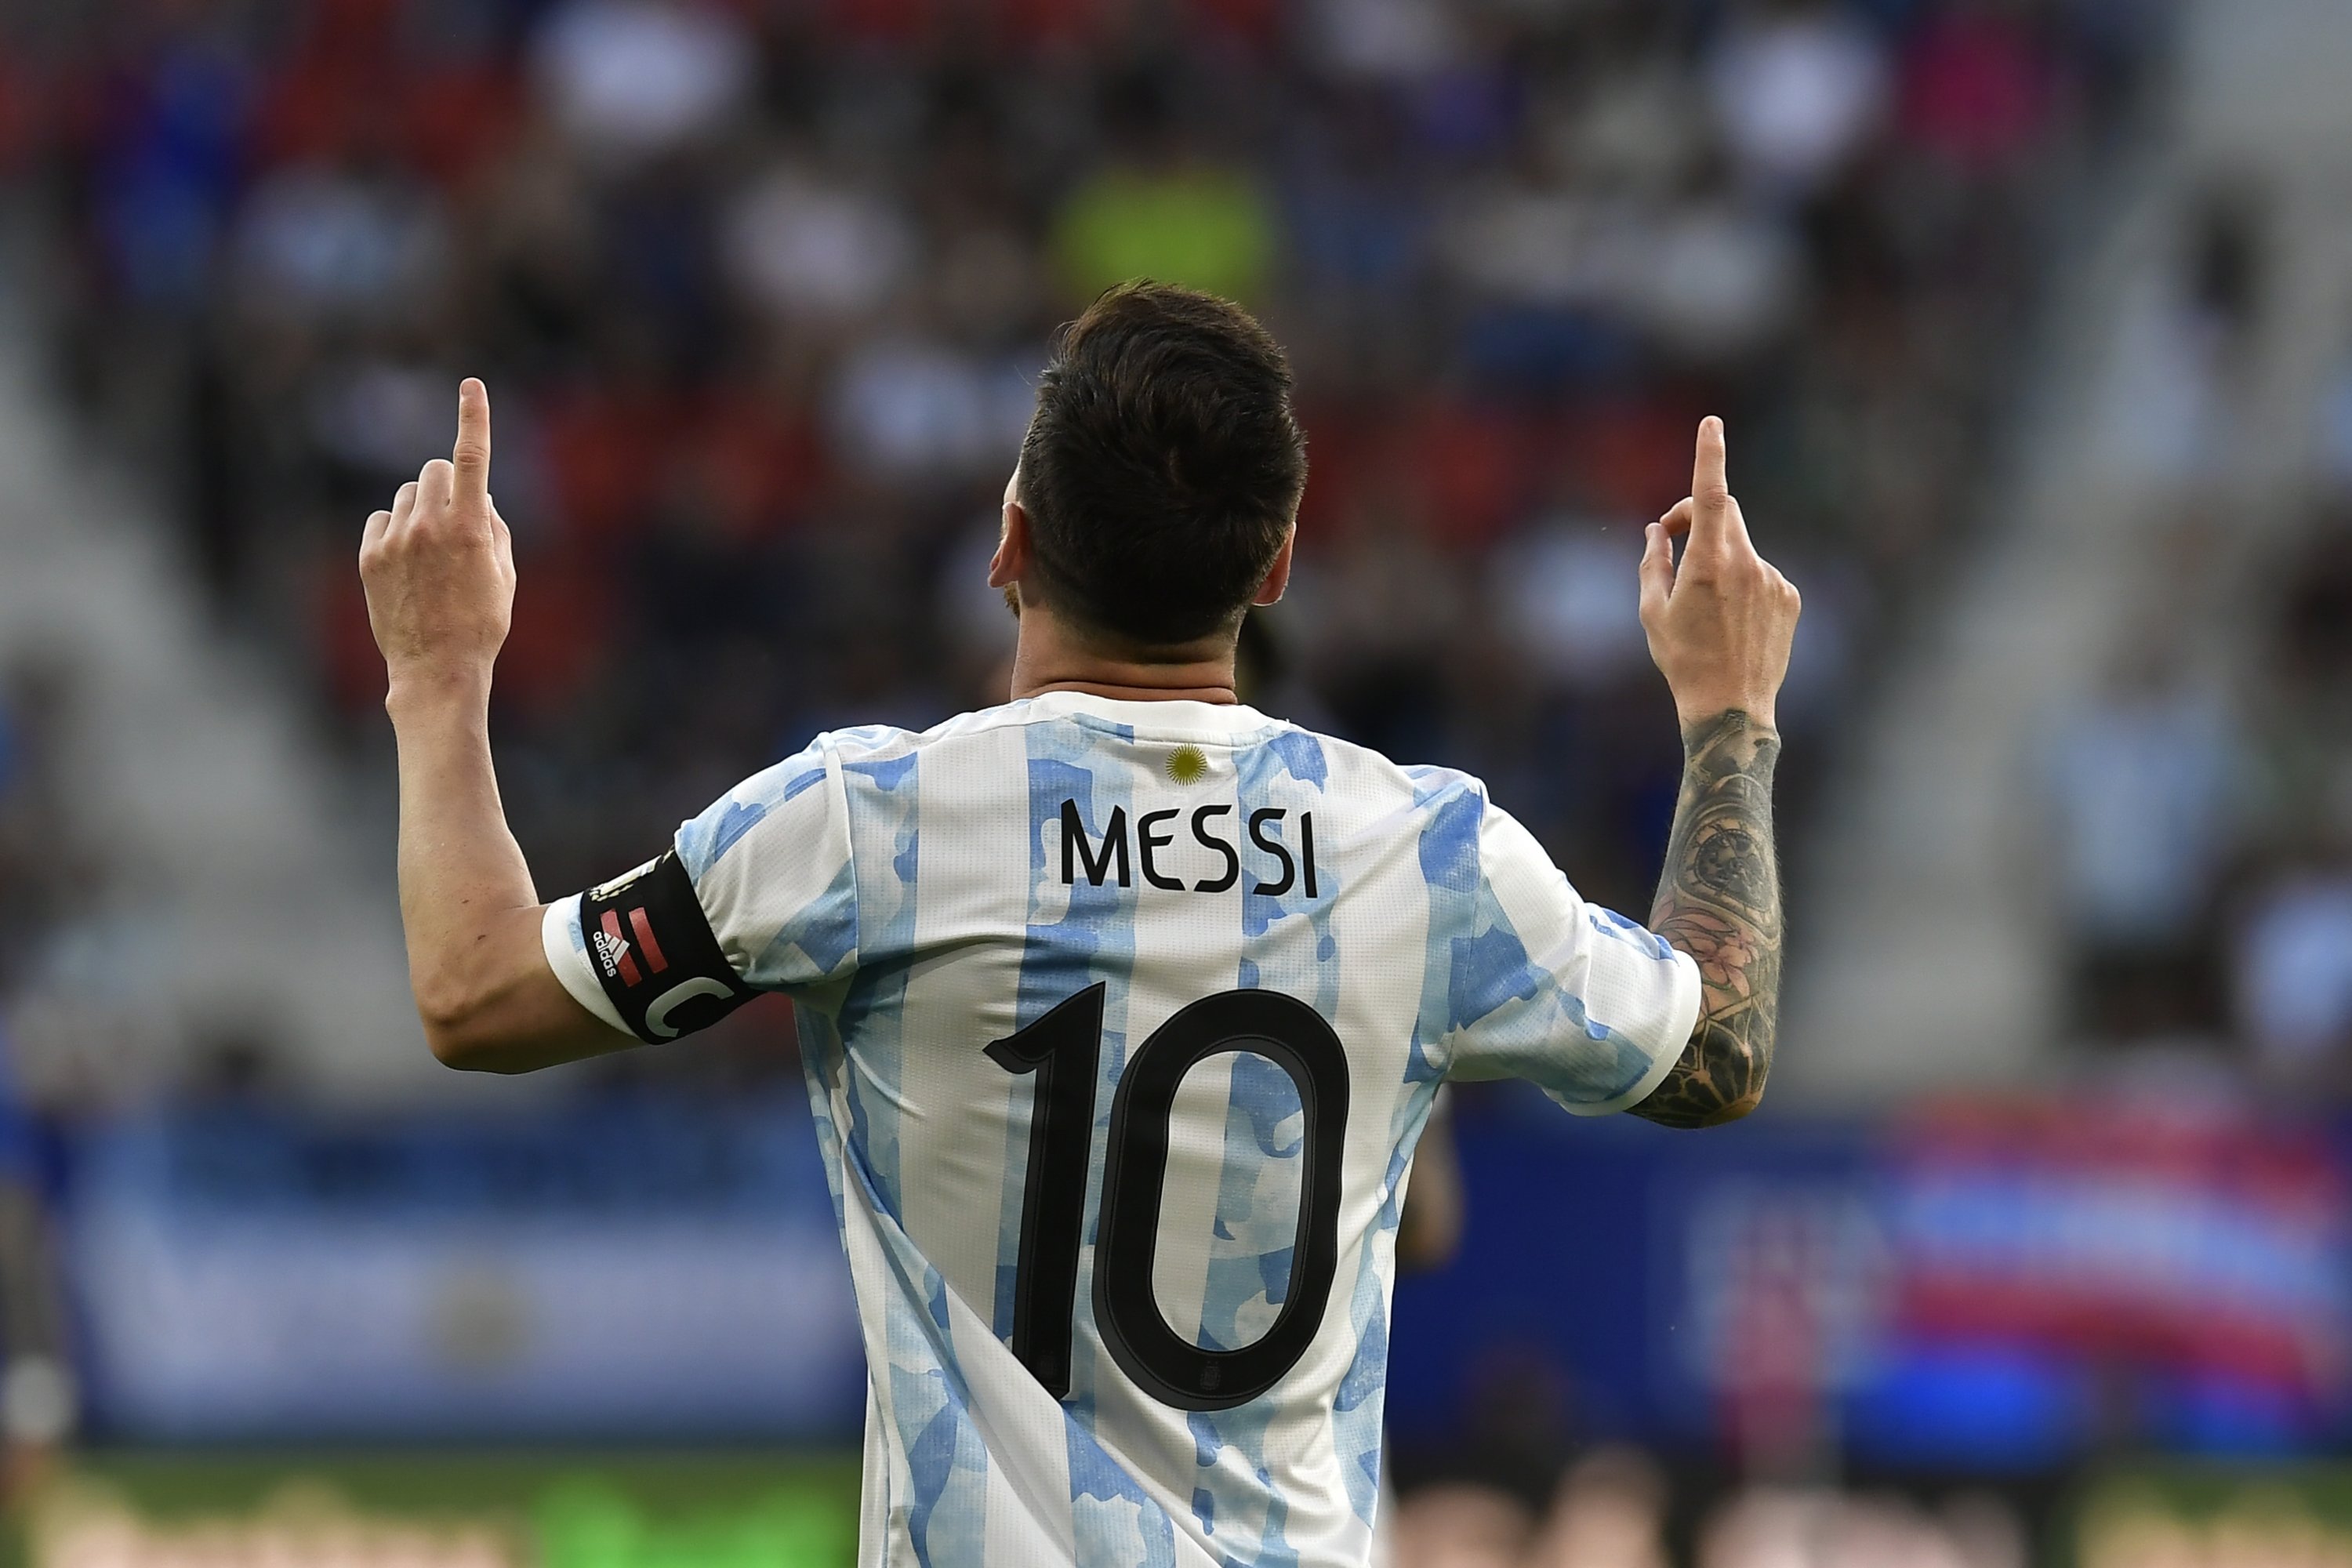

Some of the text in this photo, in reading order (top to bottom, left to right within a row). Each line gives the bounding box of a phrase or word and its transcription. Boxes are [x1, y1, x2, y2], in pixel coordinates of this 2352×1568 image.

[1061, 798, 1318, 898] MESSI
[593, 931, 617, 978] adidas
[645, 977, 735, 1037] C
[982, 981, 1349, 1412] 10
